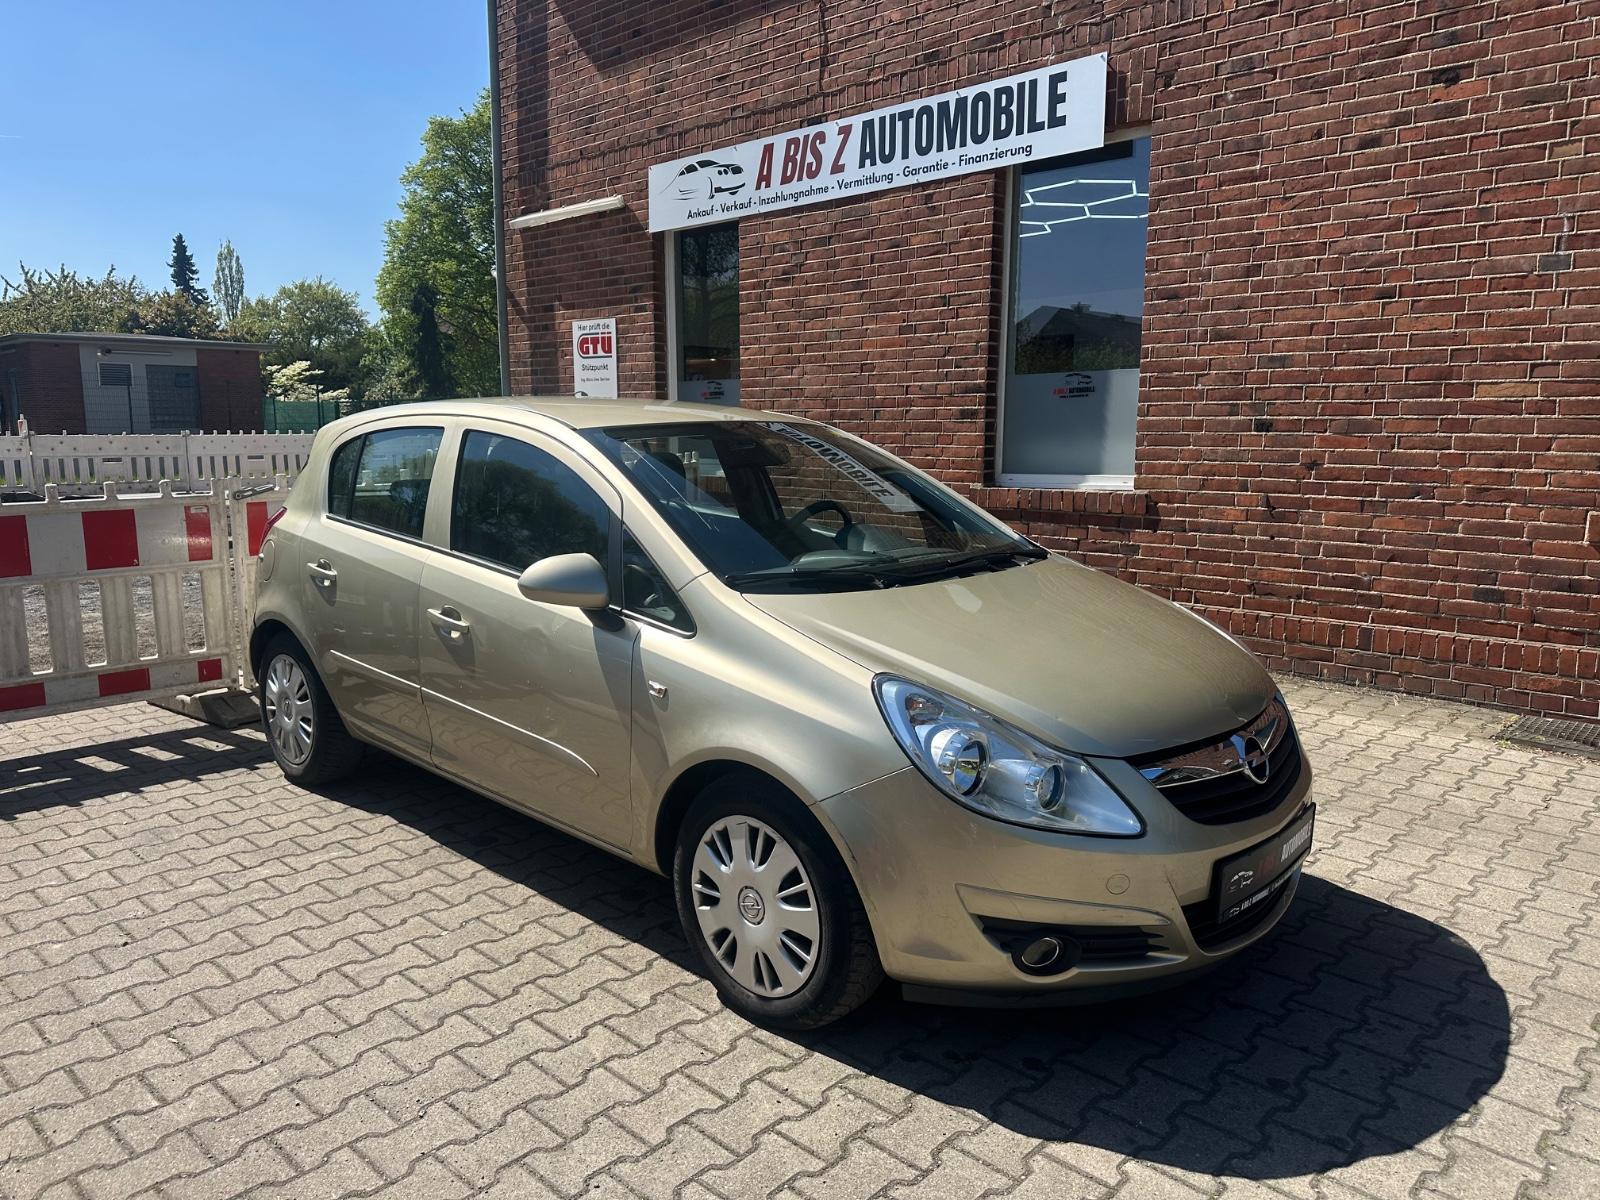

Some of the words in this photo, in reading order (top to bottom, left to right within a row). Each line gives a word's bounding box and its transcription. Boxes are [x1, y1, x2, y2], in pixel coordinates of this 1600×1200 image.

[755, 142, 775, 191] A
[780, 130, 826, 186] BIS
[830, 123, 853, 175] Z
[858, 70, 1068, 169] AUTOMOBILE
[687, 204, 714, 220] Ankauf
[720, 196, 752, 214] Verkauf
[758, 184, 829, 206] Inzahlungnahme
[837, 171, 894, 191] Vermittlung
[902, 158, 949, 177] Garantie
[958, 144, 1033, 166] Finanzierung
[577, 323, 588, 332] Hier
[588, 323, 601, 333] prüft
[602, 322, 610, 330] die
[579, 332, 612, 356] GTÜ
[581, 363, 609, 373] Stützpunkt
